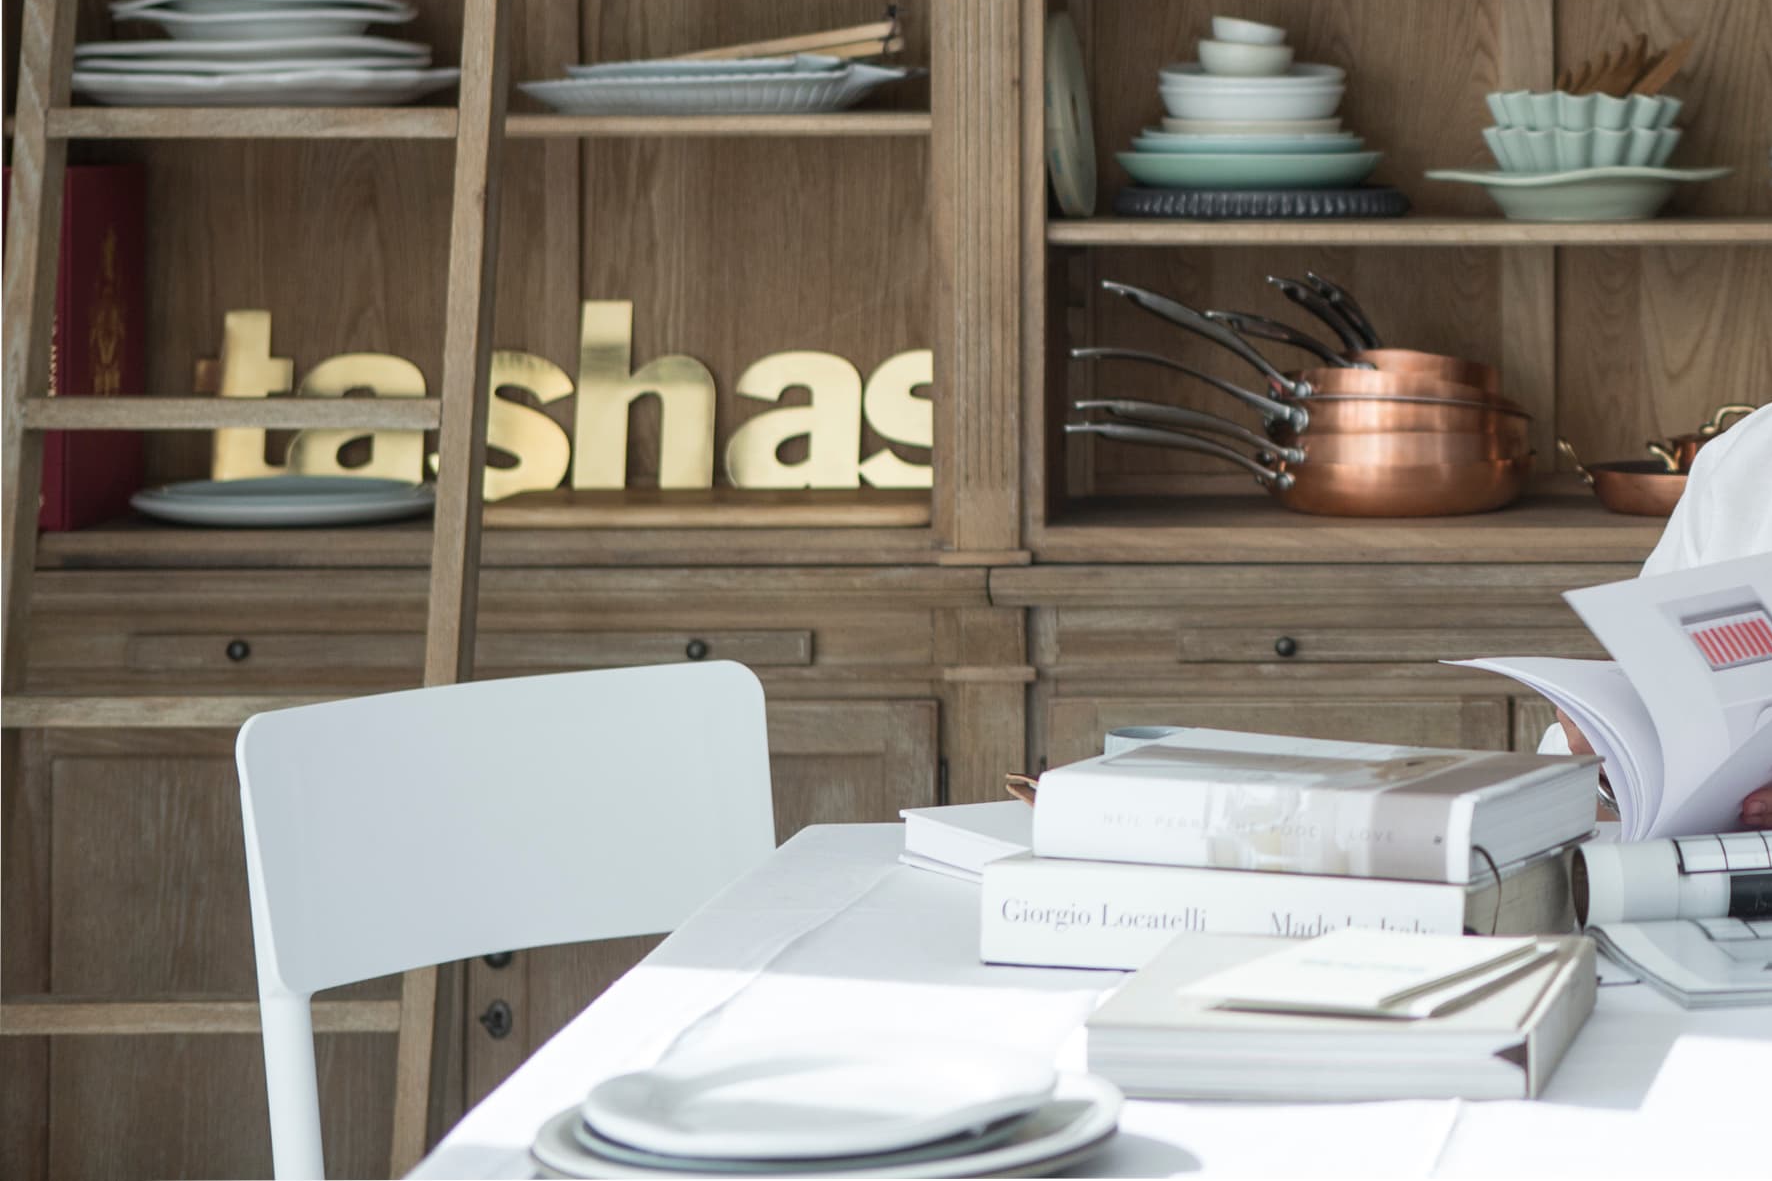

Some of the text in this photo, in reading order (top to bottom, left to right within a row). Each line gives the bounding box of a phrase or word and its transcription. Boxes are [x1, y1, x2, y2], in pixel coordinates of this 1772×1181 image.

[1000, 898, 1207, 932] Giorgio Locatelli
[1269, 911, 1336, 937] Made
